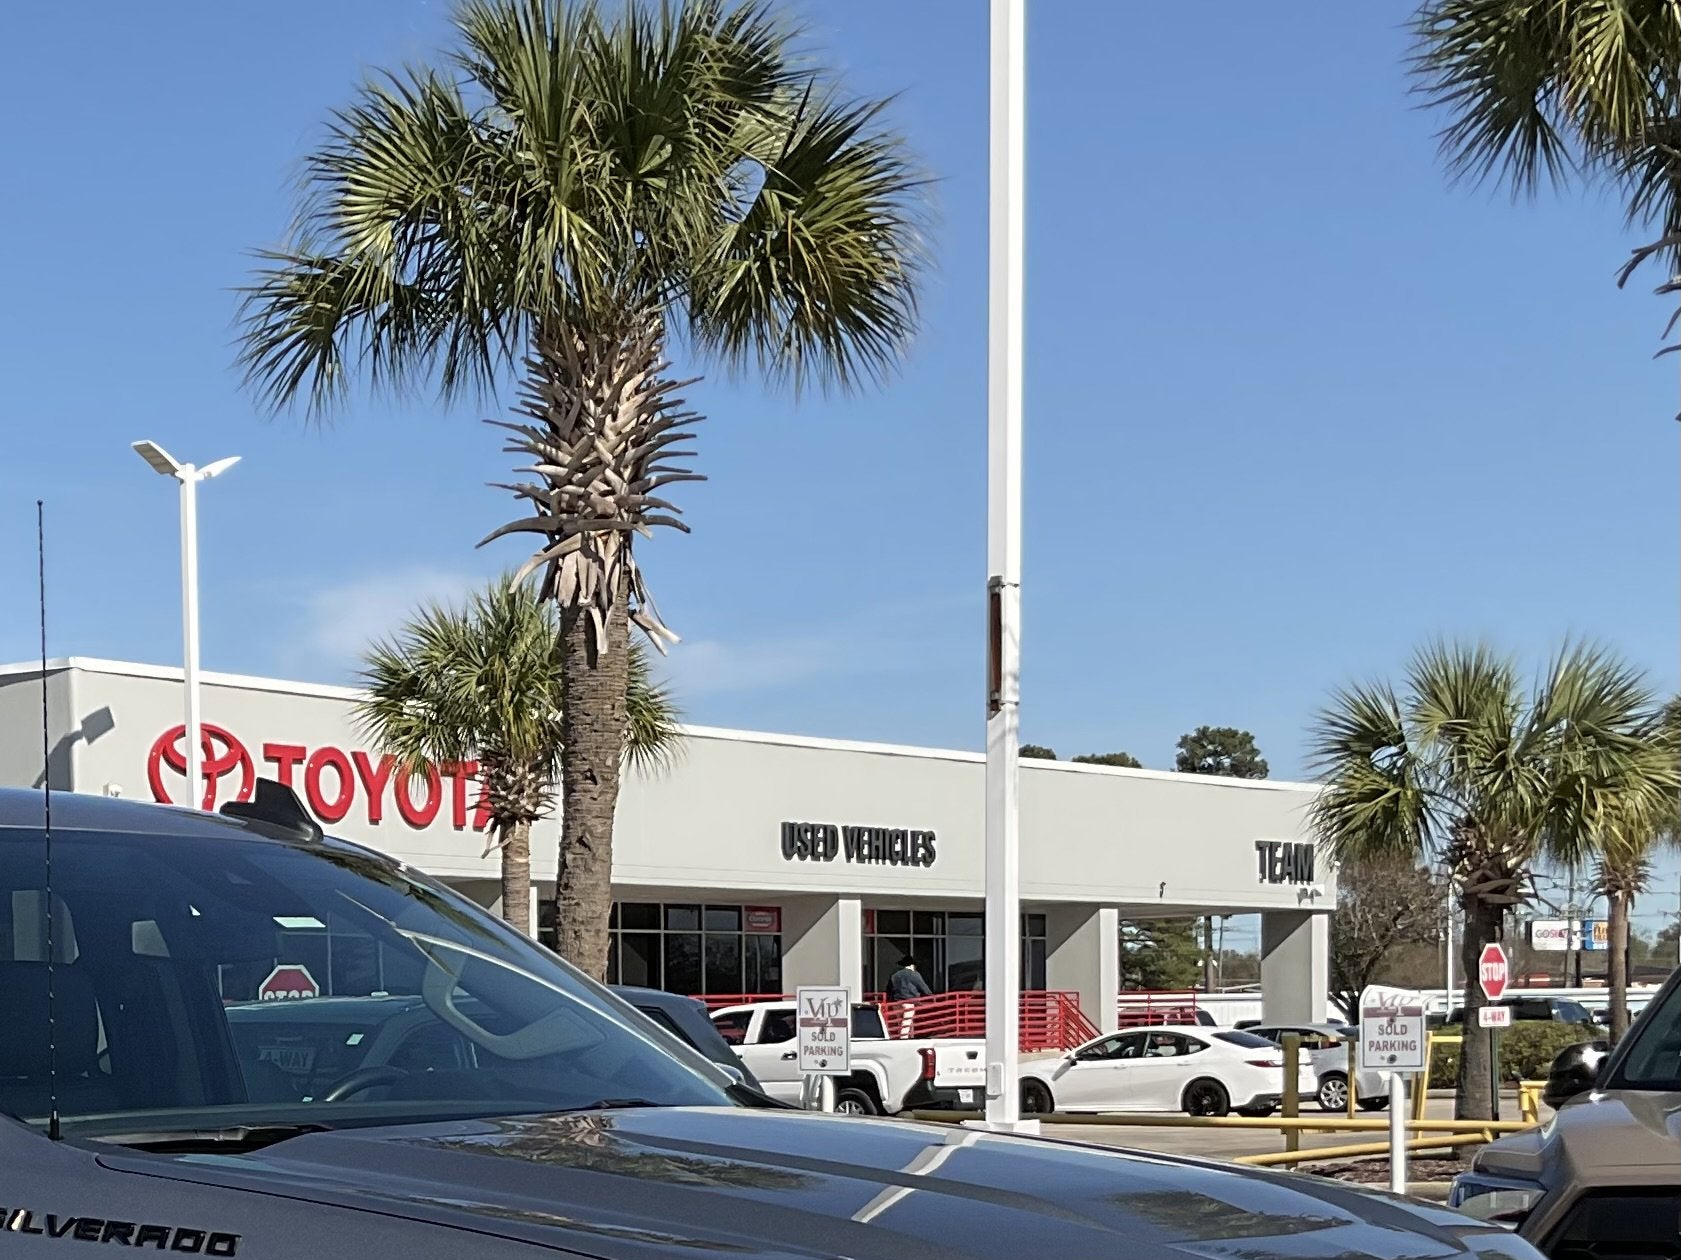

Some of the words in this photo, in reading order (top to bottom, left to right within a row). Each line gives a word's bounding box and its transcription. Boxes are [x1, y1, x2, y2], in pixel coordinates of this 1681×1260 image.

[781, 822, 838, 861] USED
[841, 826, 936, 867] VEHICLES
[1255, 841, 1314, 884] TEAM
[1482, 962, 1505, 981] STOP
[1484, 1011, 1505, 1022] 4-WAY
[1378, 1024, 1408, 1036] SOLD
[811, 1031, 836, 1042] SOLD
[803, 1045, 844, 1056] PARKING
[1368, 1040, 1417, 1052] PARKING
